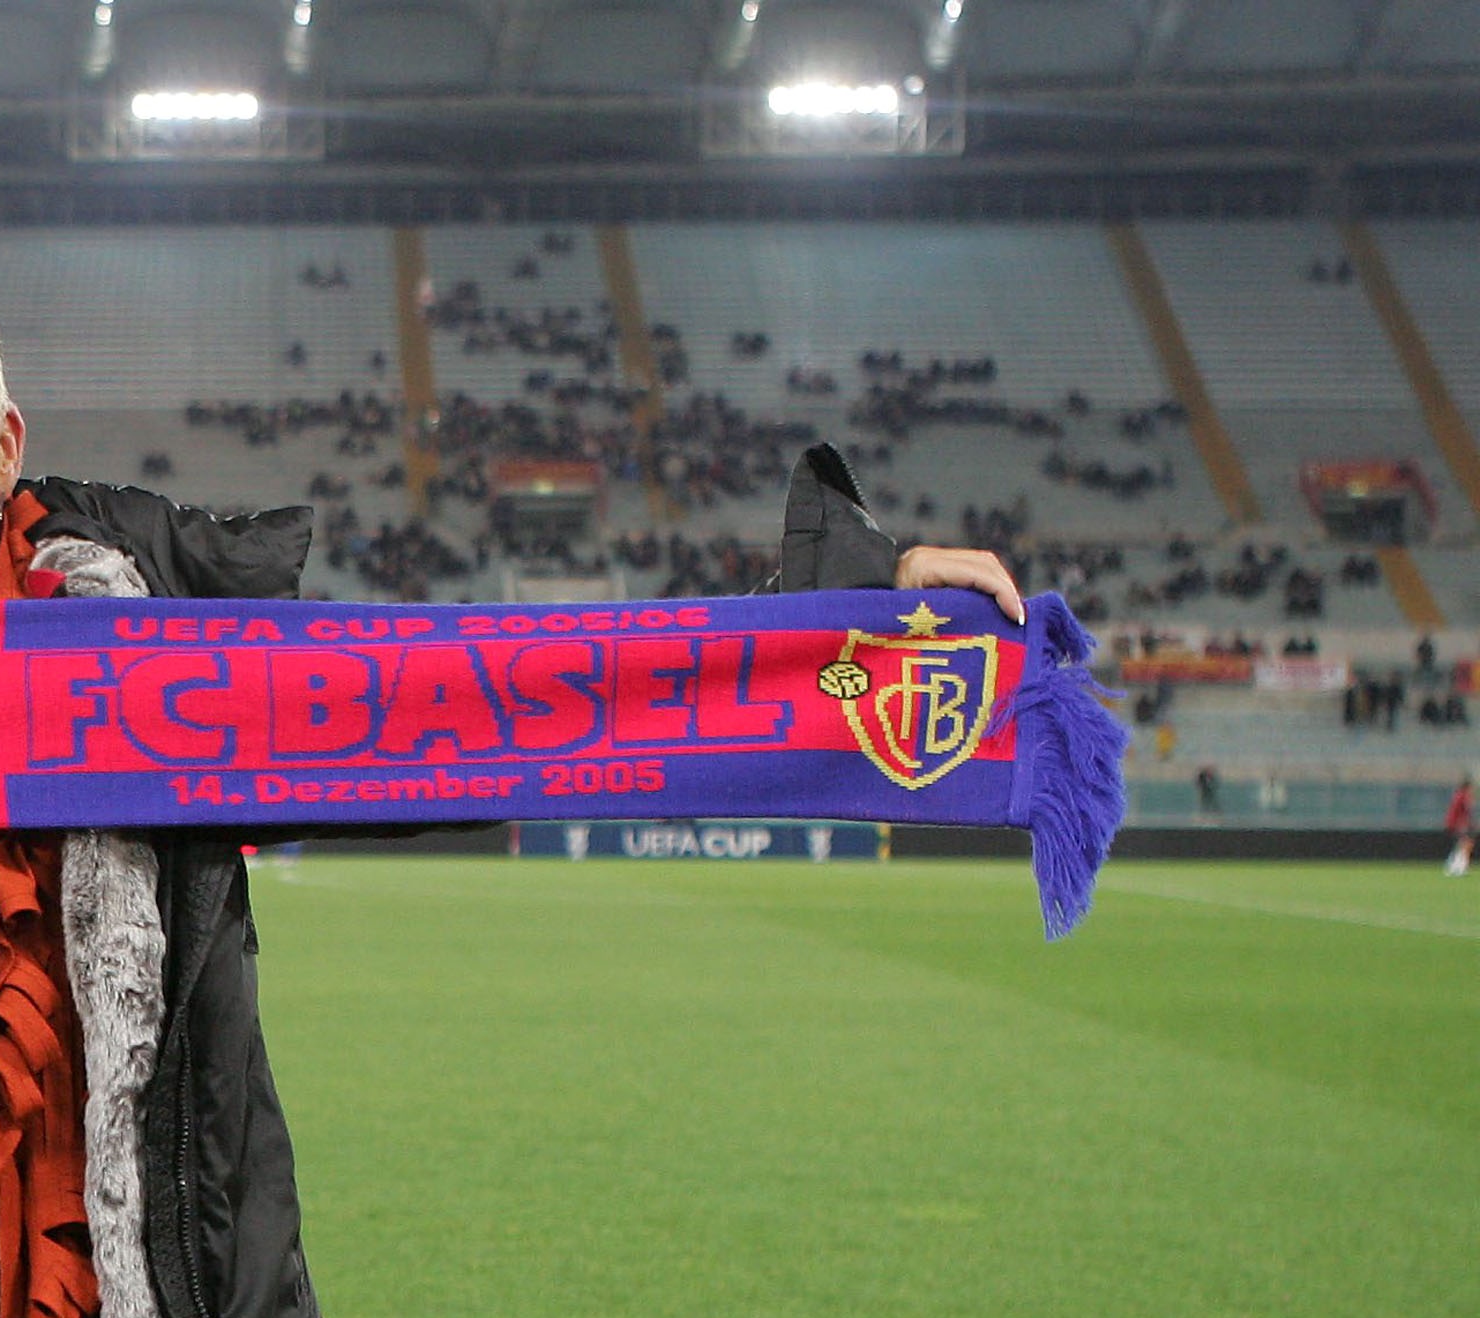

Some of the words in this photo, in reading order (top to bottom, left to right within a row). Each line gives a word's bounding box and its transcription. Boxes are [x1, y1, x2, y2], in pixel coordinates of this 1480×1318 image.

[114, 616, 283, 642] UEFA
[305, 616, 435, 640] CUP
[26, 650, 238, 769] FC
[266, 634, 794, 762] BASEL
[168, 774, 246, 806] 14.
[255, 770, 523, 804] Dezember
[540, 760, 665, 796] 2005
[625, 827, 702, 858] UEFA
[704, 827, 773, 858] CUP
